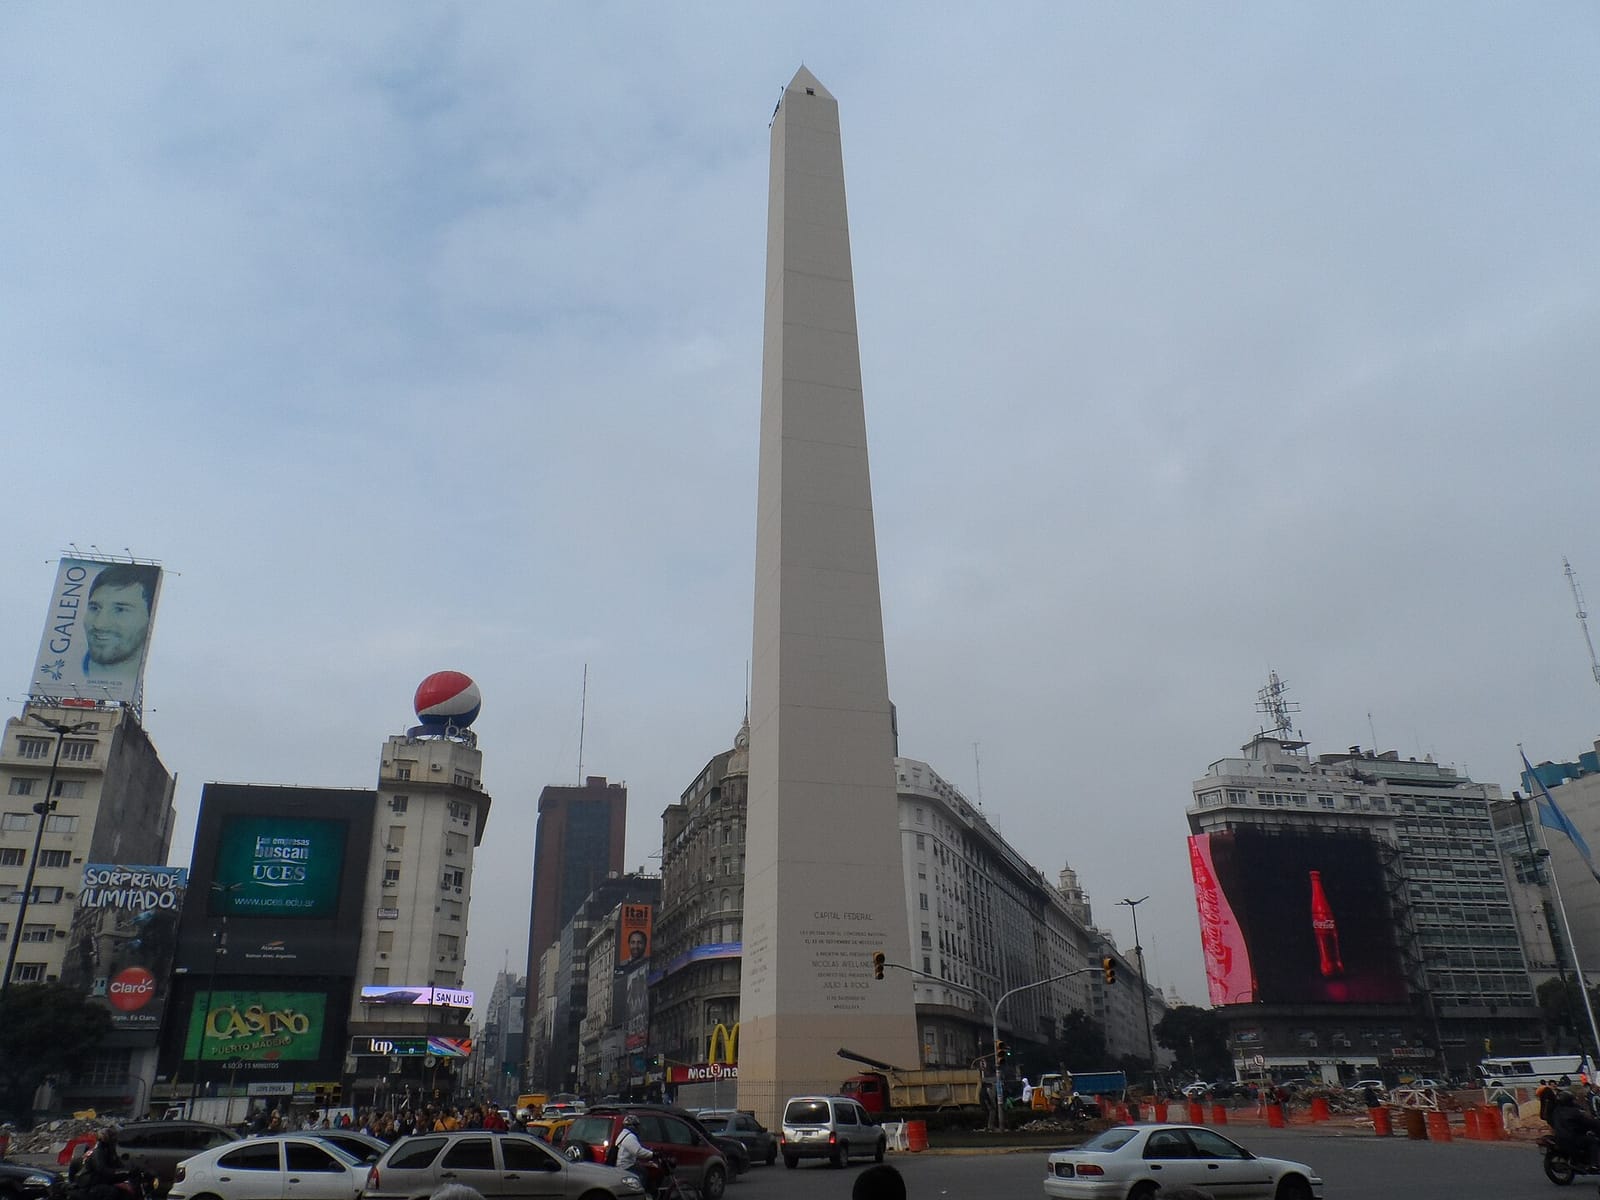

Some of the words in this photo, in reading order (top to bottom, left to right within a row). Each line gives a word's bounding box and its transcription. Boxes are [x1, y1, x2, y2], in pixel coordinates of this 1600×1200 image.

[50, 566, 87, 654] GALENO
[255, 845, 309, 859] buscan
[86, 868, 182, 889] SORPRENDÉ
[252, 865, 306, 881] UCES
[81, 888, 177, 912] ILIMITADO.
[814, 911, 840, 920] CAPITAL
[843, 912, 873, 921] FEDERAL
[110, 982, 147, 993] Claro
[435, 992, 452, 1003] SAN
[453, 994, 469, 1005] LUIS
[206, 1005, 310, 1040] CASINO
[212, 1042, 251, 1055] PUERTO
[252, 1036, 292, 1050] MADERO
